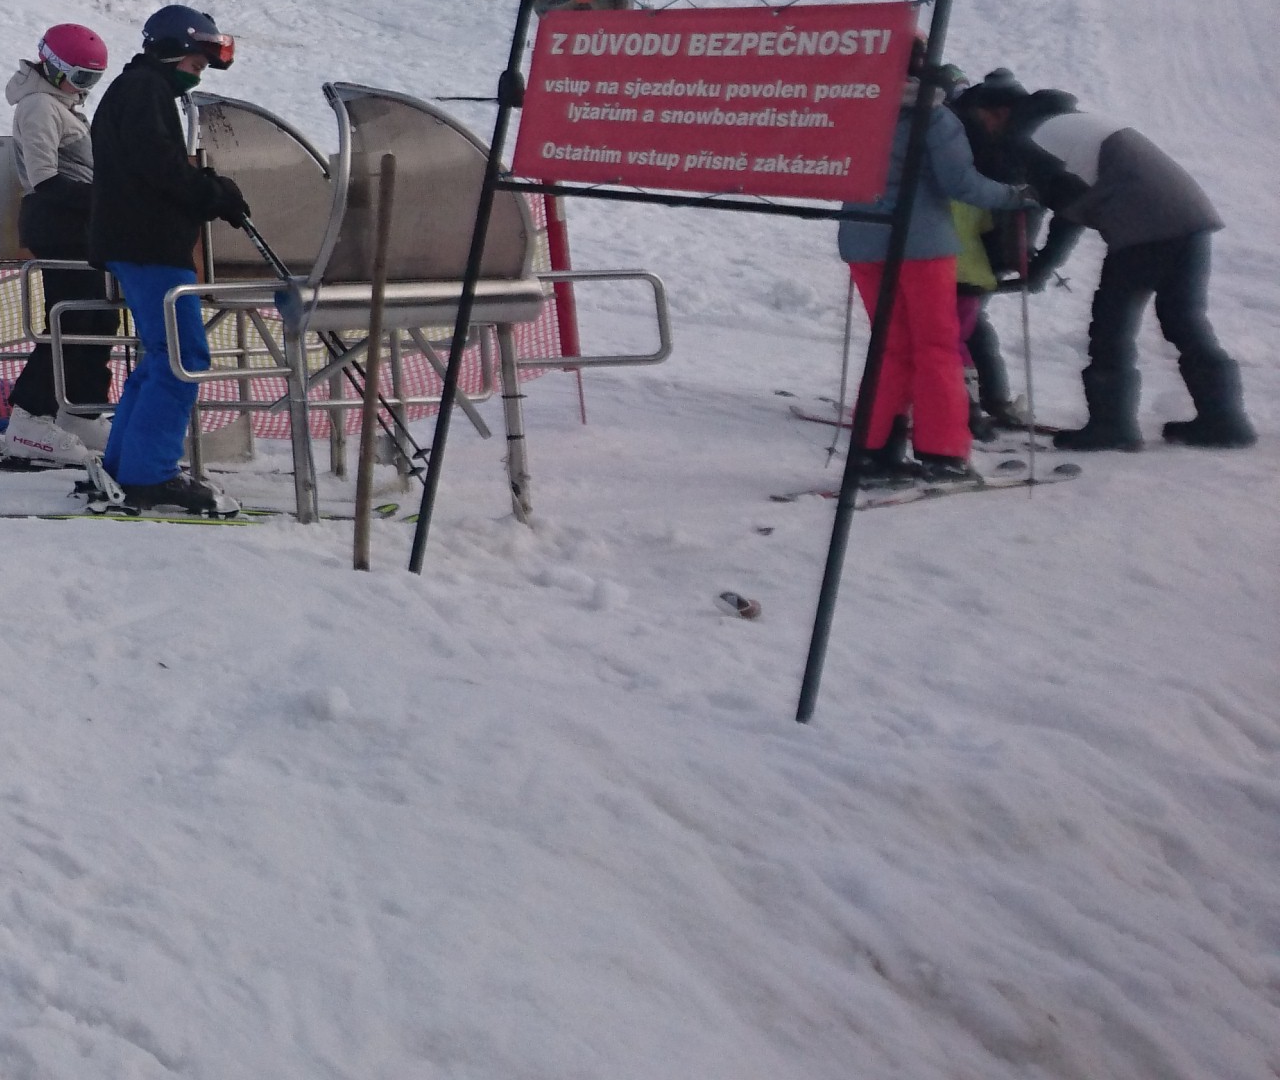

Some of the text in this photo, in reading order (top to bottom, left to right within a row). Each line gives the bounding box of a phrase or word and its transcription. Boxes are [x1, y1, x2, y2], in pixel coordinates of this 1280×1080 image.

[551, 25, 891, 56] Z DŮVODU BEZPEČNOSTI
[544, 77, 880, 102] vstup na sjezdovku povolen pouze
[568, 102, 835, 128] lyžařům a snowboardistům.
[542, 141, 851, 176] Ostatním vstup přísně zakázán!
[13, 435, 54, 453] HEAD
